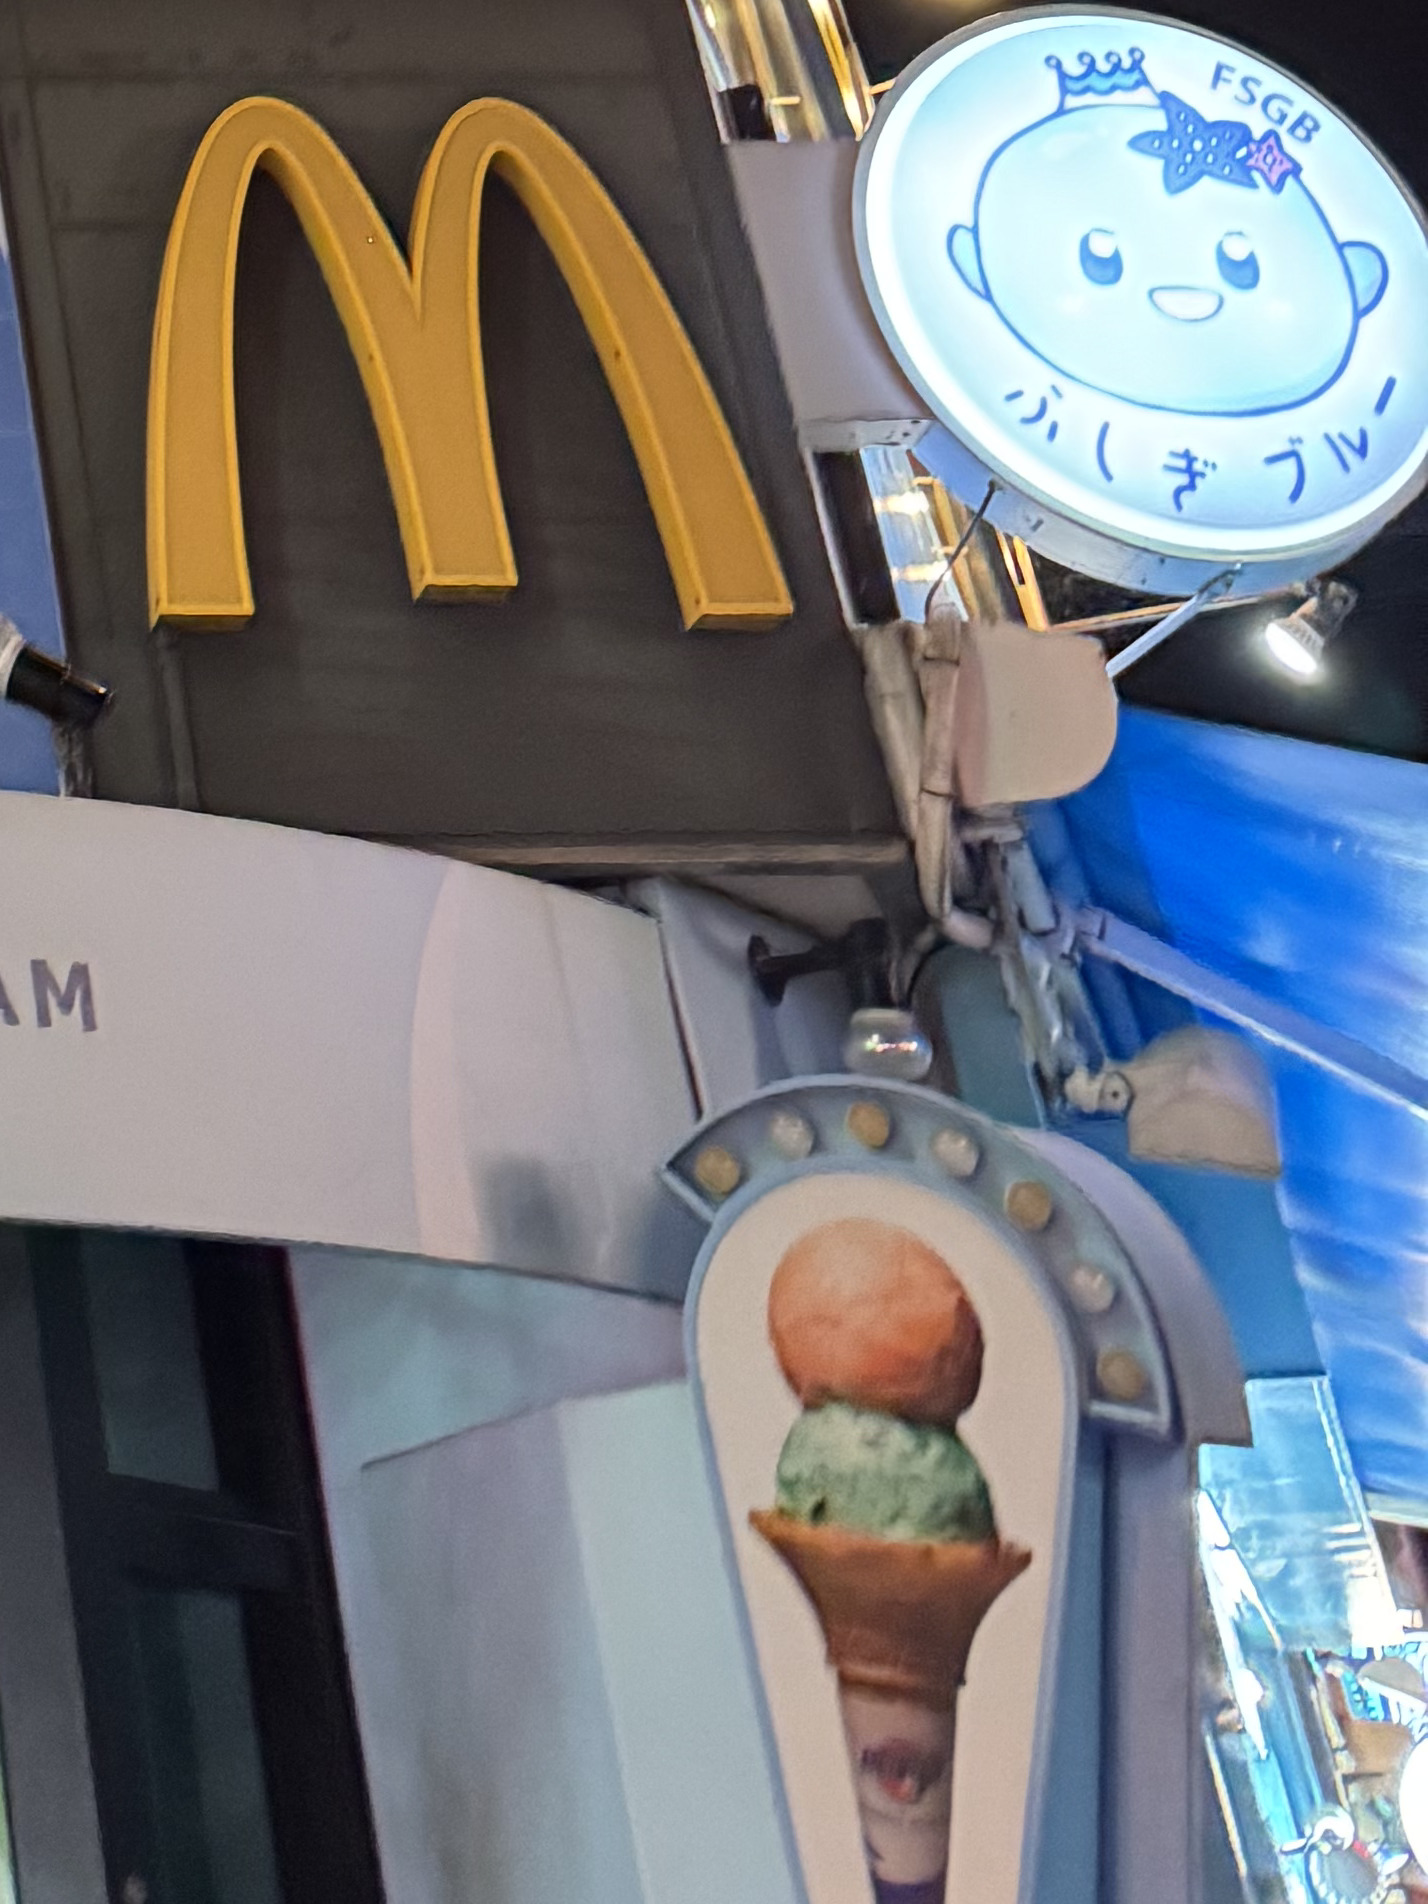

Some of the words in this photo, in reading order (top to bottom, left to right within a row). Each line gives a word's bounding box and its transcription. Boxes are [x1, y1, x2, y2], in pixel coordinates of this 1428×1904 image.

[1211, 61, 1321, 145] FSGB
[147, 96, 794, 630] M
[1004, 377, 1396, 512] ふしぎブルー
